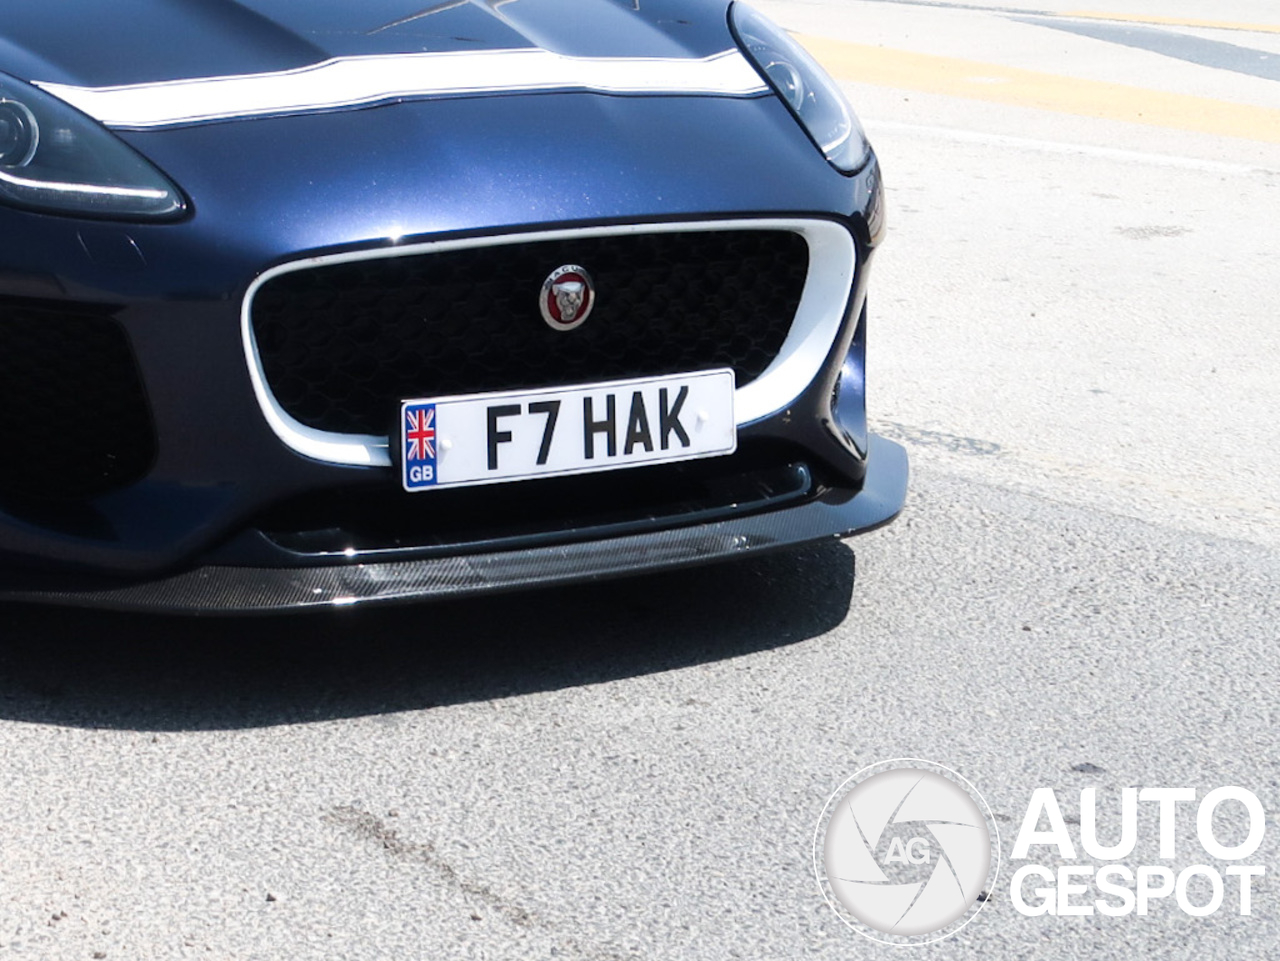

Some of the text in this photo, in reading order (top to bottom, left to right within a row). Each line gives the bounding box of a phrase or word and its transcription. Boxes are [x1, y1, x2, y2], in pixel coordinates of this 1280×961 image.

[486, 385, 691, 471] F7 HAK
[410, 465, 433, 483] GB
